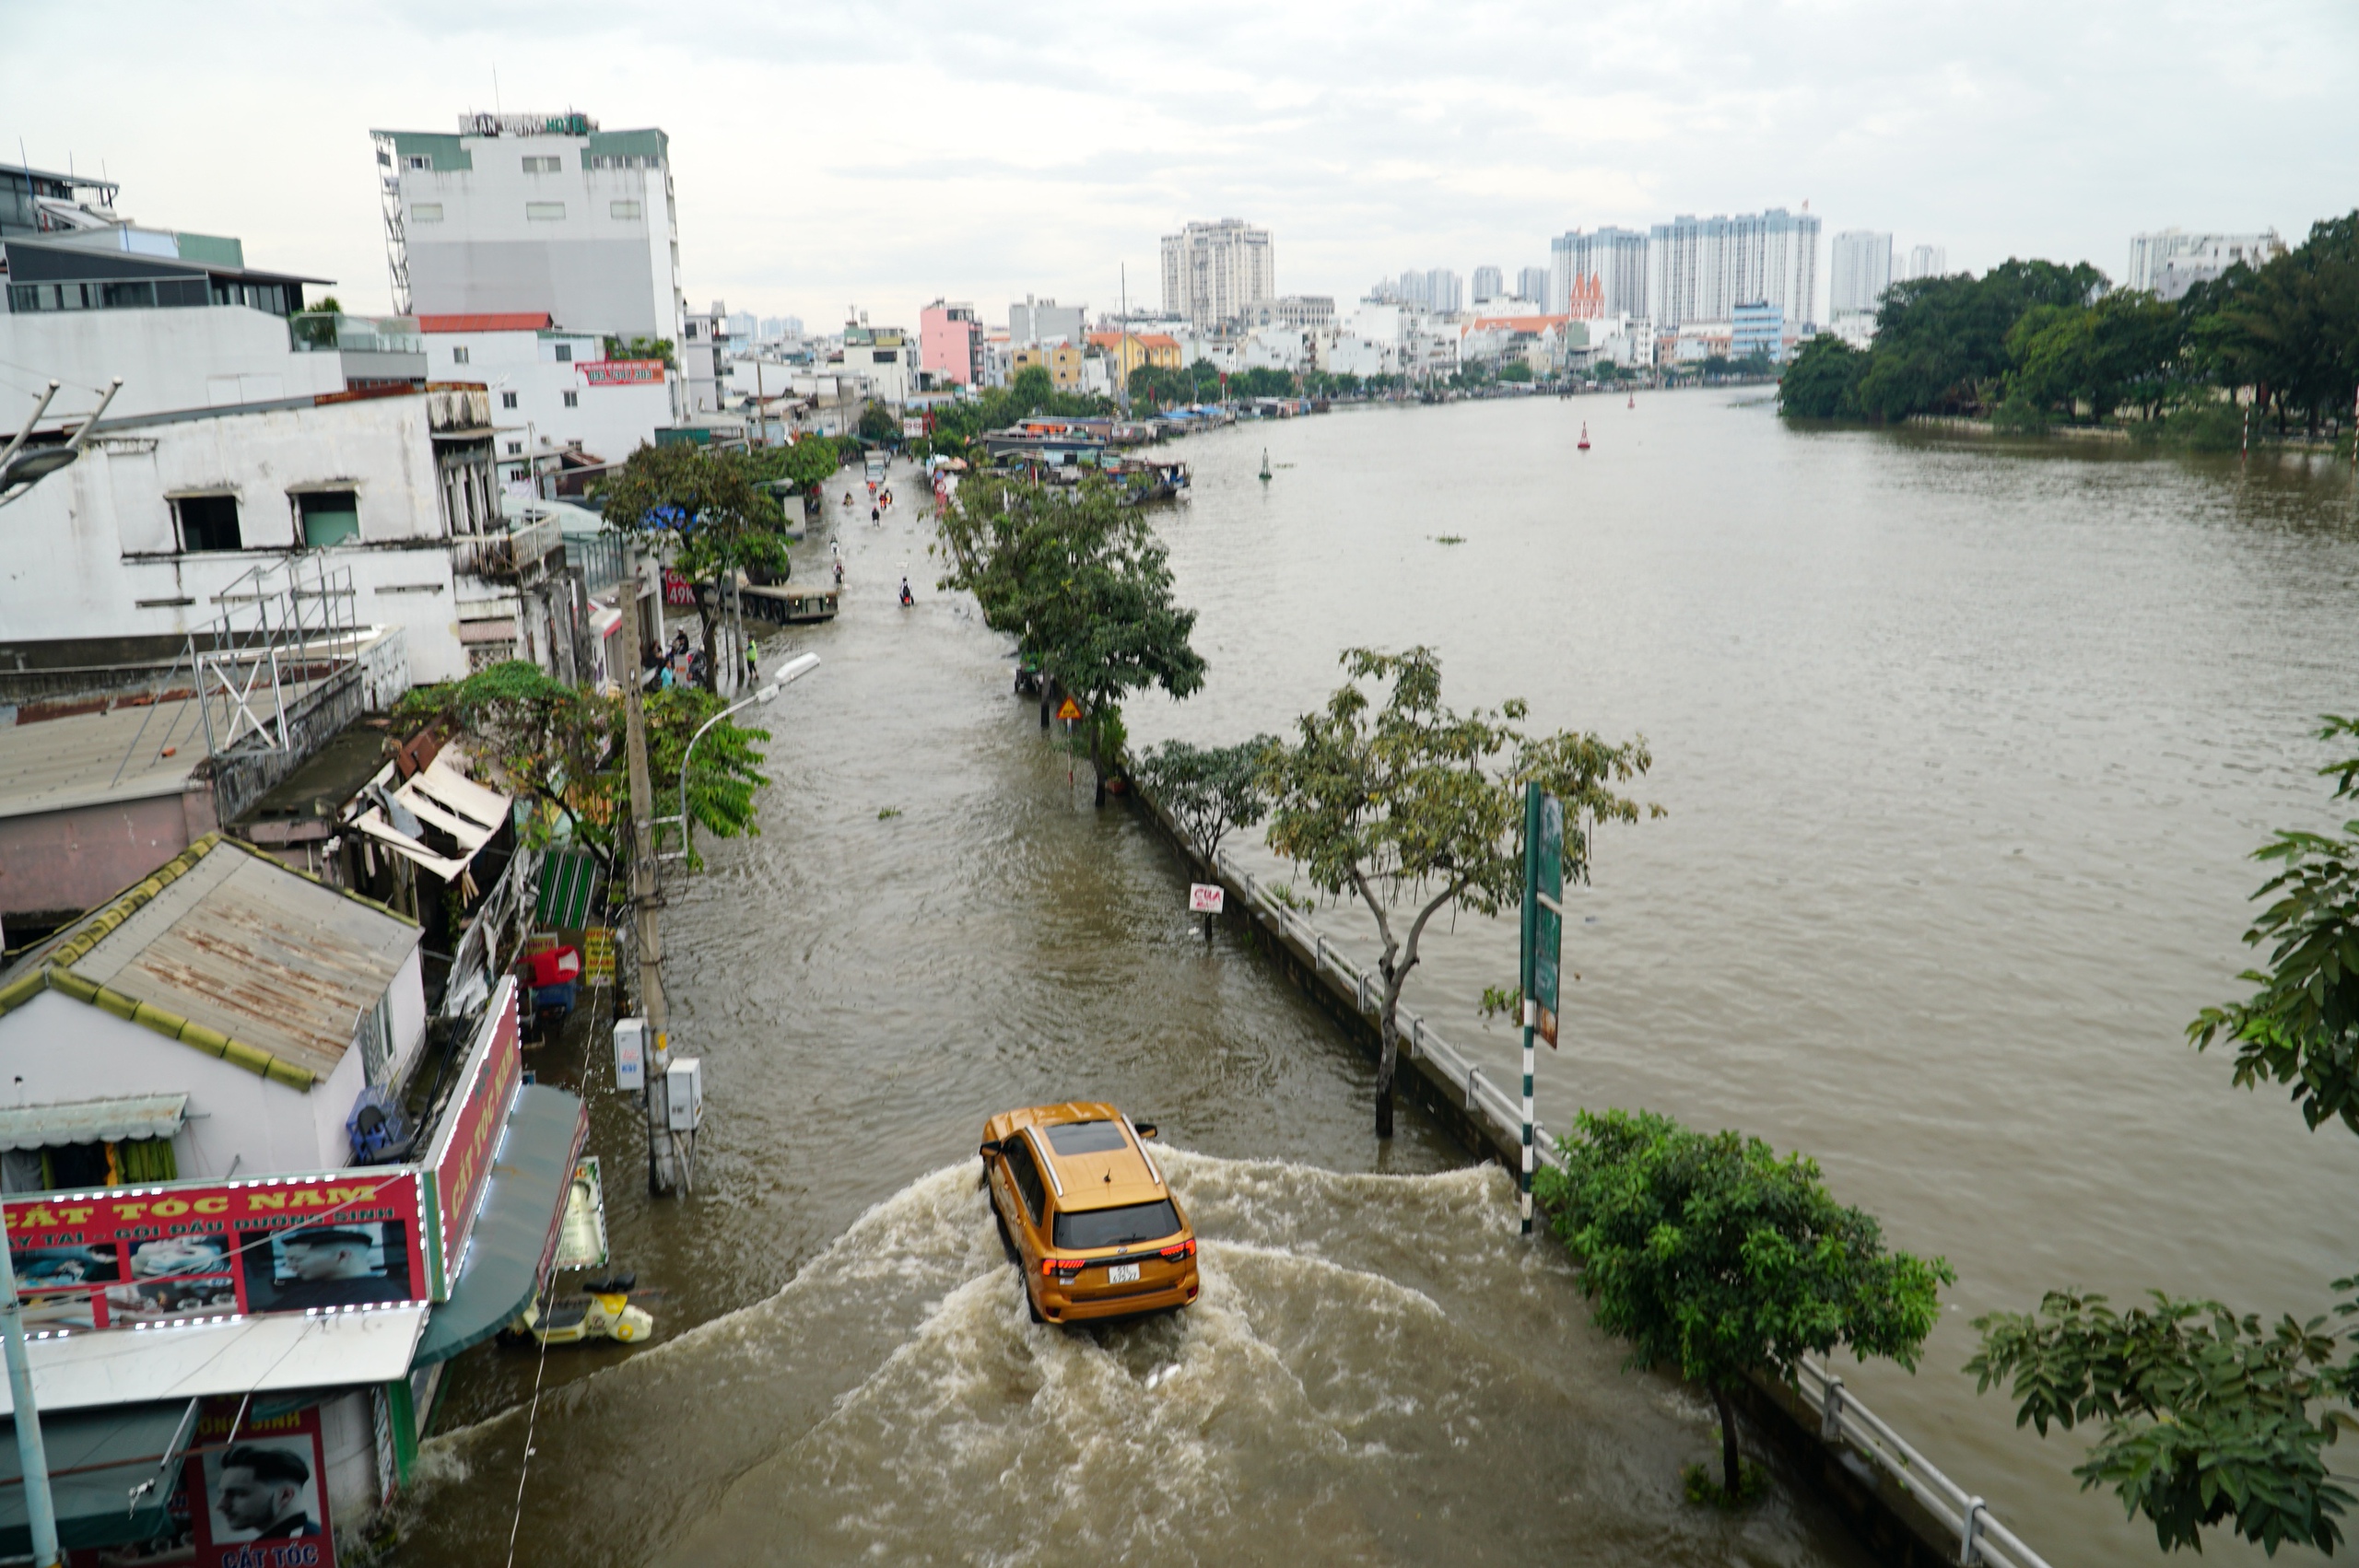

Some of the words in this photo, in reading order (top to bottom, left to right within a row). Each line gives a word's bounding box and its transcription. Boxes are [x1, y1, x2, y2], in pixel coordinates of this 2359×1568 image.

[546, 113, 587, 133] HOTEL
[474, 1093, 496, 1159] TÓC
[496, 1035, 514, 1104] NAM
[112, 1196, 229, 1221] TÓC
[247, 1184, 377, 1211] NAM
[41, 1231, 85, 1246] TAI
[333, 1207, 395, 1223] SINH
[221, 1542, 267, 1568] CẮT
[271, 1539, 320, 1567] TÓC
